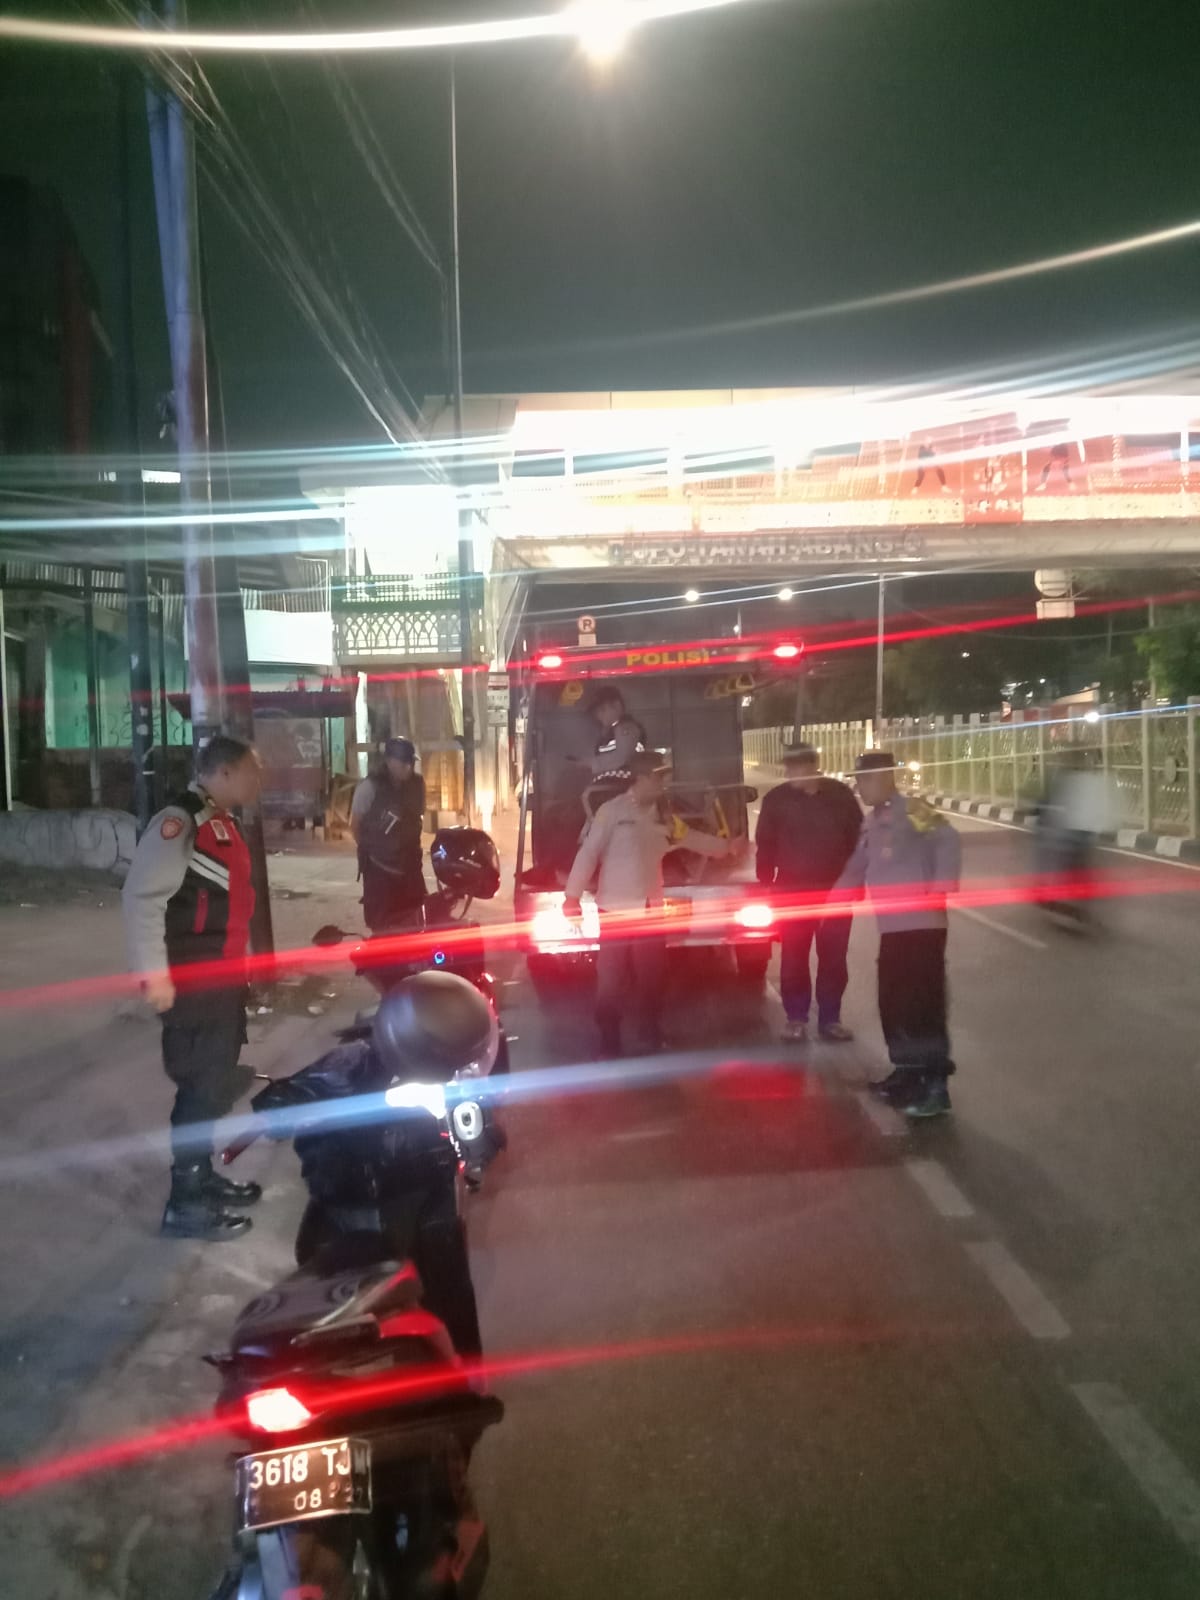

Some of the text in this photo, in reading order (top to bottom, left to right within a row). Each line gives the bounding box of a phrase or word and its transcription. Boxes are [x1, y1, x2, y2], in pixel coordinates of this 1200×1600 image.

[626, 650, 710, 666] POLISI
[250, 1451, 309, 1489] 3618
[294, 1488, 322, 1510] 08
